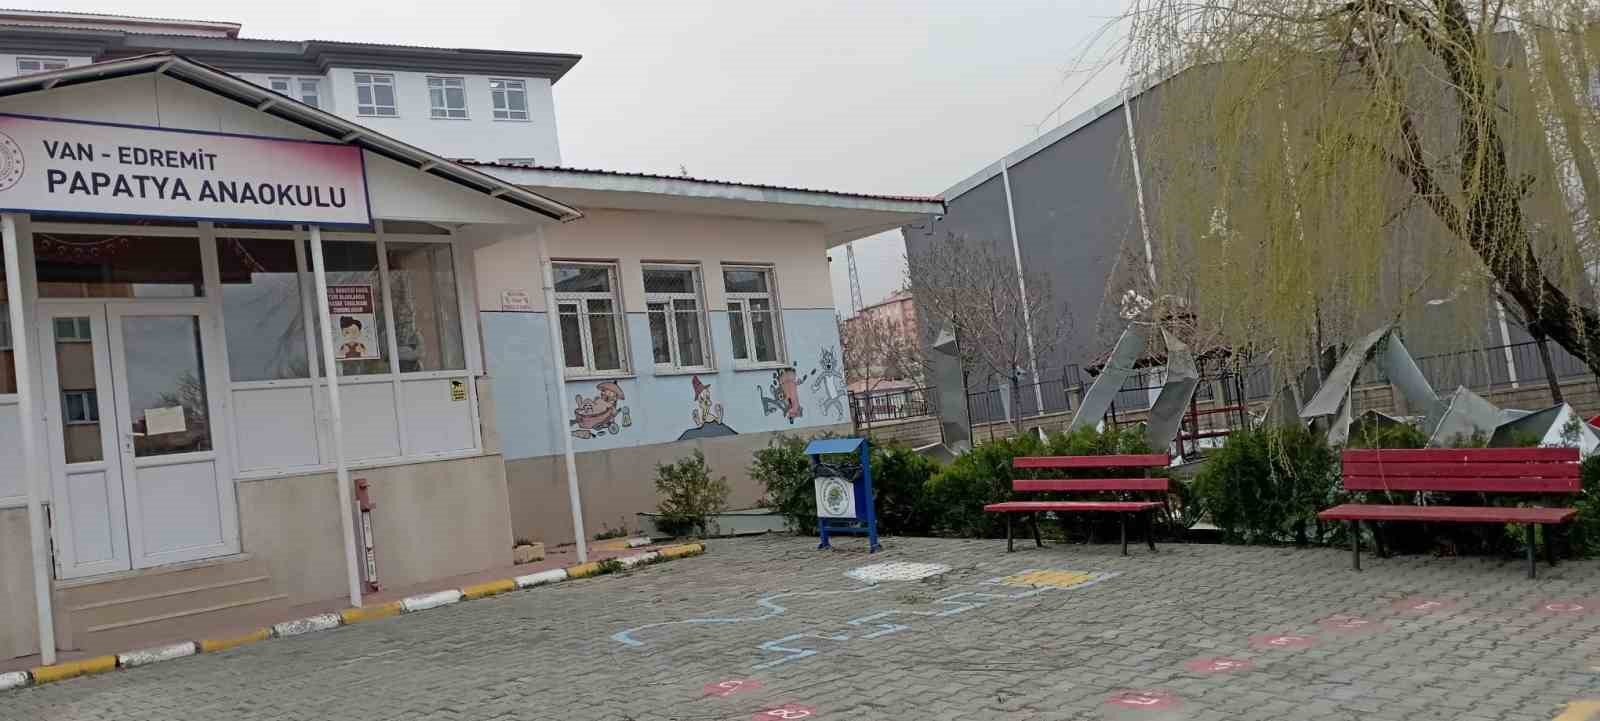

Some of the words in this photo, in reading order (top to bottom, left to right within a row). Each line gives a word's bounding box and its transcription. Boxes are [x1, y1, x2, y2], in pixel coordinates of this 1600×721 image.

[43, 140, 93, 161] VAN
[118, 147, 217, 171] EDREMİT
[47, 169, 191, 201] PAPATYA
[199, 180, 346, 208] ANAOKULU
